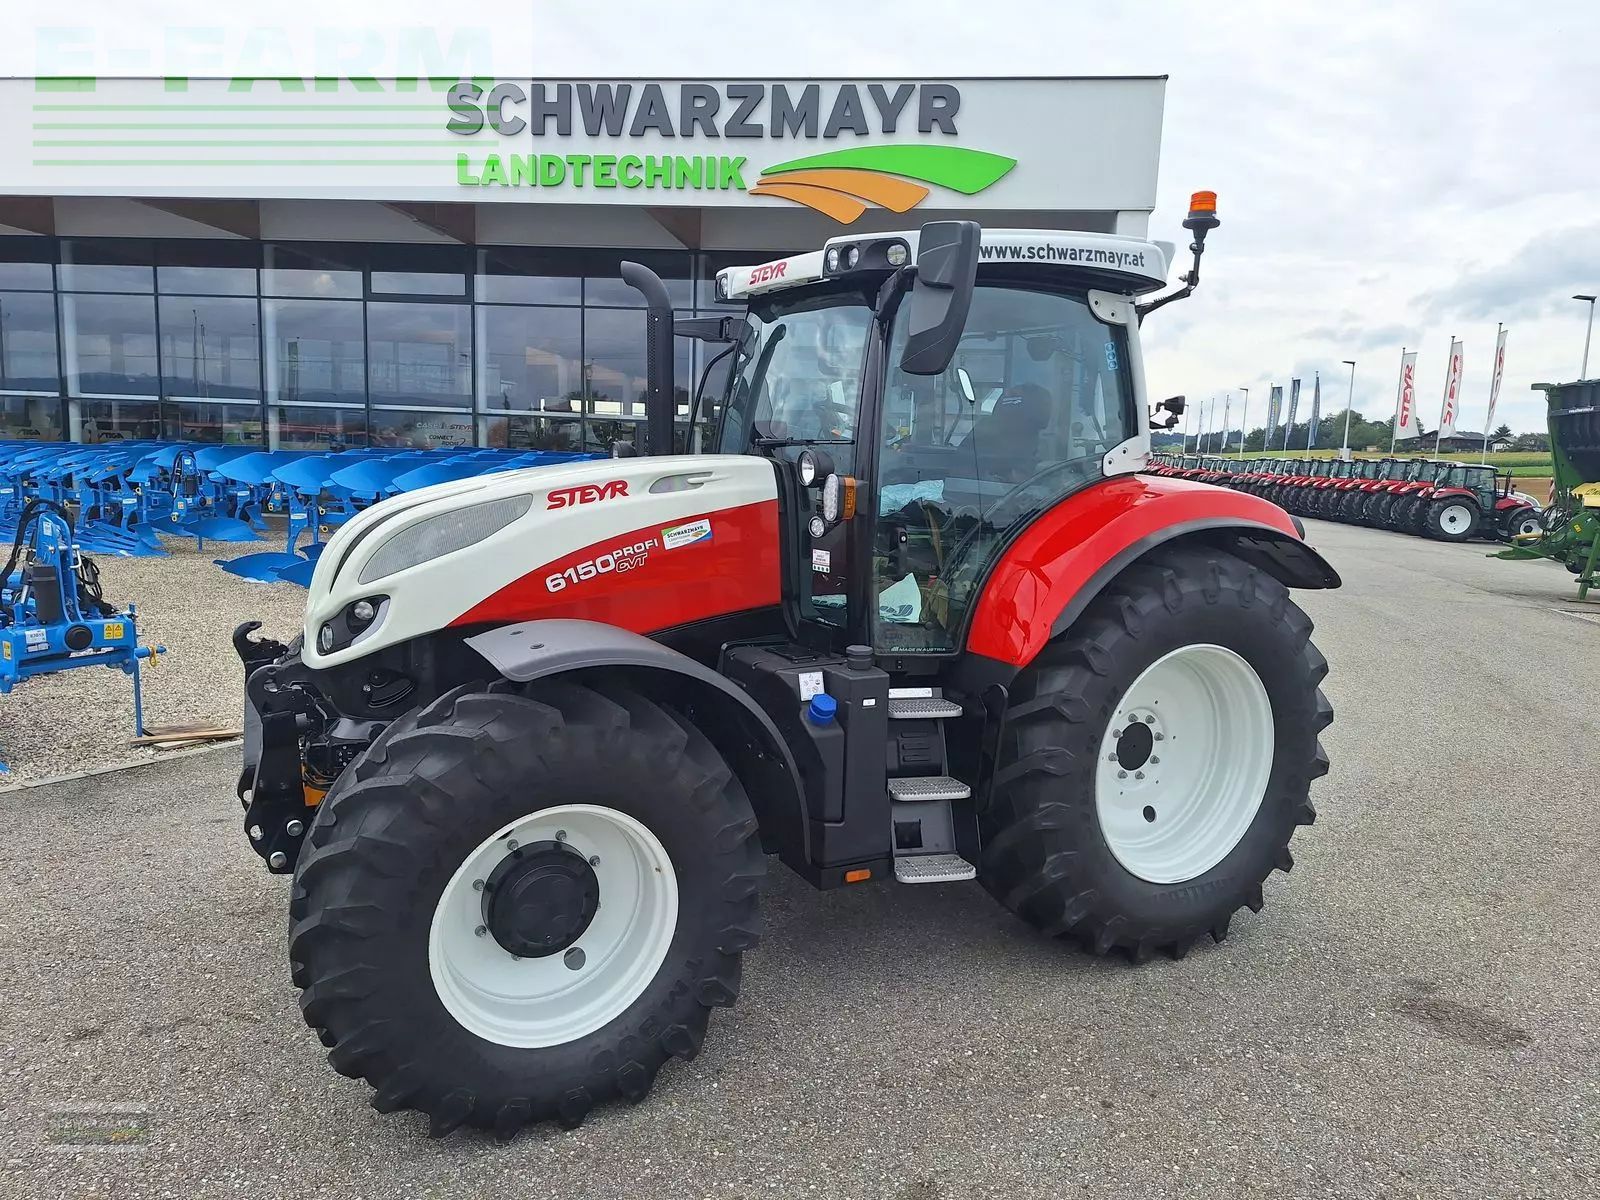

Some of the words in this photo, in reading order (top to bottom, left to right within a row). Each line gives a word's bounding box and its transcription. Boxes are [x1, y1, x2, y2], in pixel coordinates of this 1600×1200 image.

[445, 82, 962, 138] SCHWARZMAYR
[456, 152, 748, 191] LANDTECHNIK
[979, 243, 1146, 268] www.schwarzmayr.at
[748, 261, 788, 286] STEYR
[1400, 363, 1413, 428] STEYR
[546, 479, 630, 511] STEYR
[545, 553, 617, 593] 6150
[613, 537, 660, 560] PROFI
[615, 552, 649, 574] CVT
